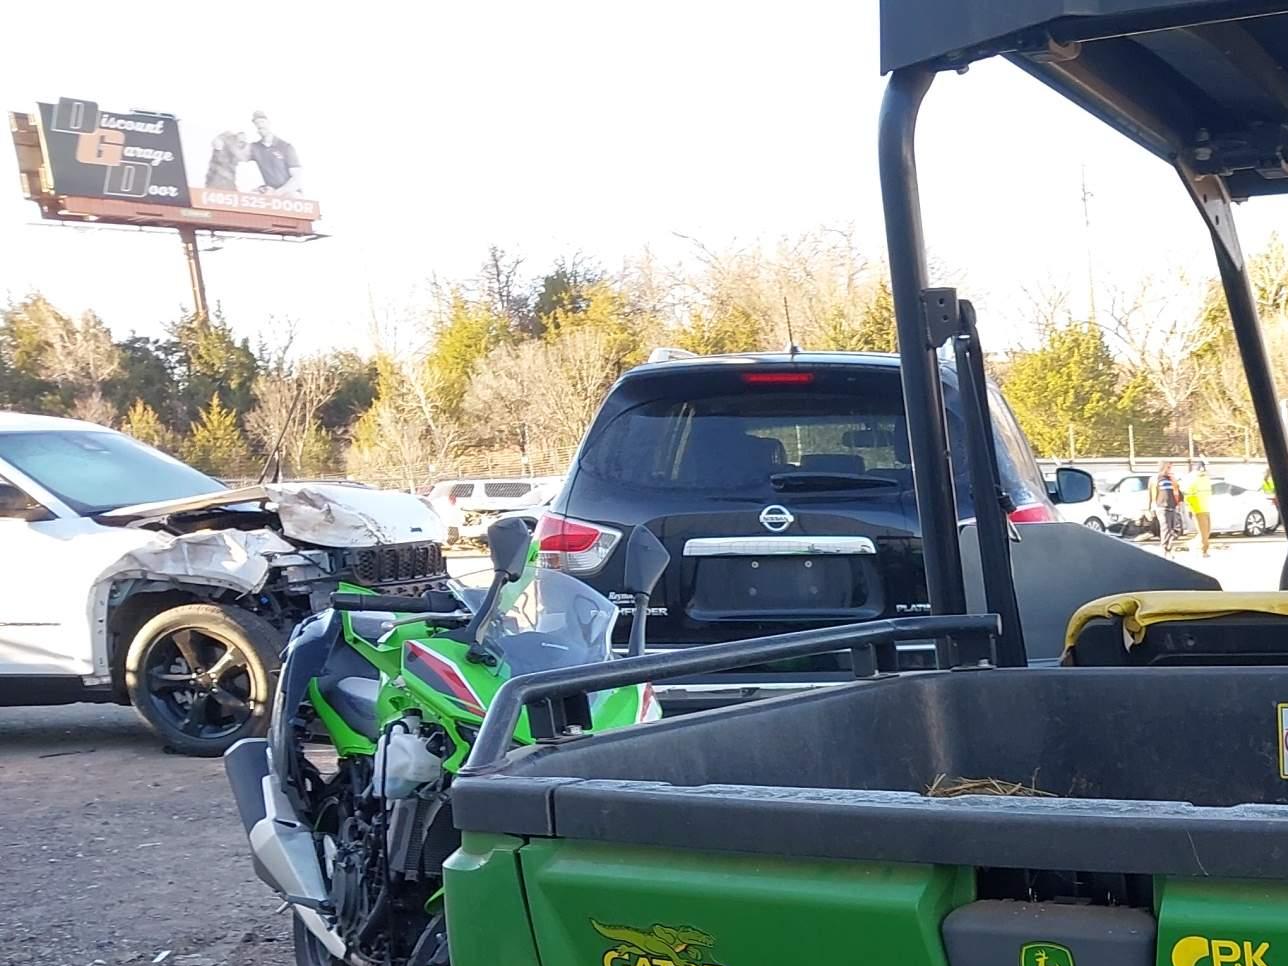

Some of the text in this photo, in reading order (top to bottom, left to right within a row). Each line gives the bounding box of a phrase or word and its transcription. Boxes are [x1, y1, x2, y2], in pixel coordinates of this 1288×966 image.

[51, 97, 164, 134] Discount
[76, 128, 174, 166] Garage
[103, 159, 179, 197] Door
